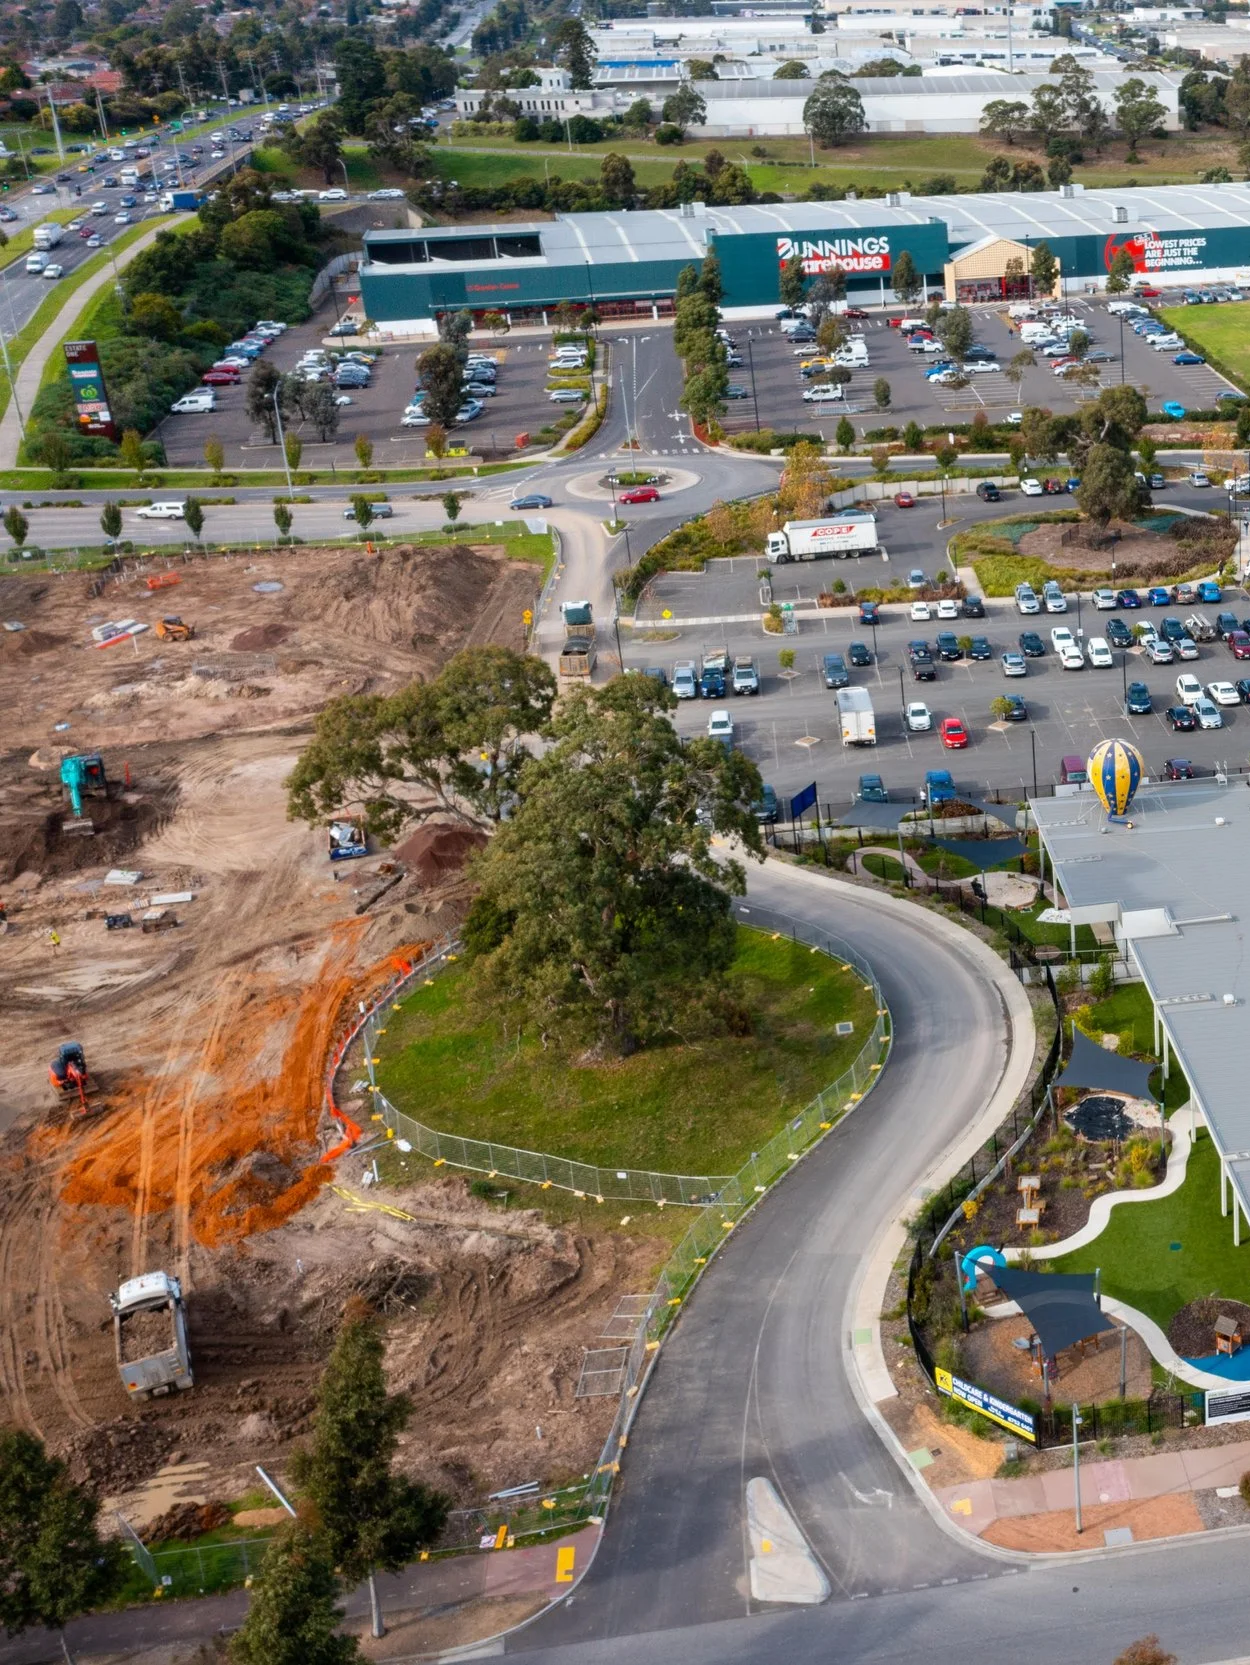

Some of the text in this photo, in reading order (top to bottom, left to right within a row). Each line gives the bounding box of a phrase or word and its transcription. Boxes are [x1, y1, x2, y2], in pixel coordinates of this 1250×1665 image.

[777, 237, 889, 259] BUNNINGS
[1144, 237, 1207, 250] LOWEST PRICES
[1145, 247, 1198, 258] ARE JUST THE
[790, 252, 884, 273] arehouse
[817, 526, 849, 537] COPE
[953, 1377, 983, 1399] CHILDCARE
[989, 1396, 1033, 1425] KINDERGARTEN
[967, 1393, 983, 1408] OPEN
